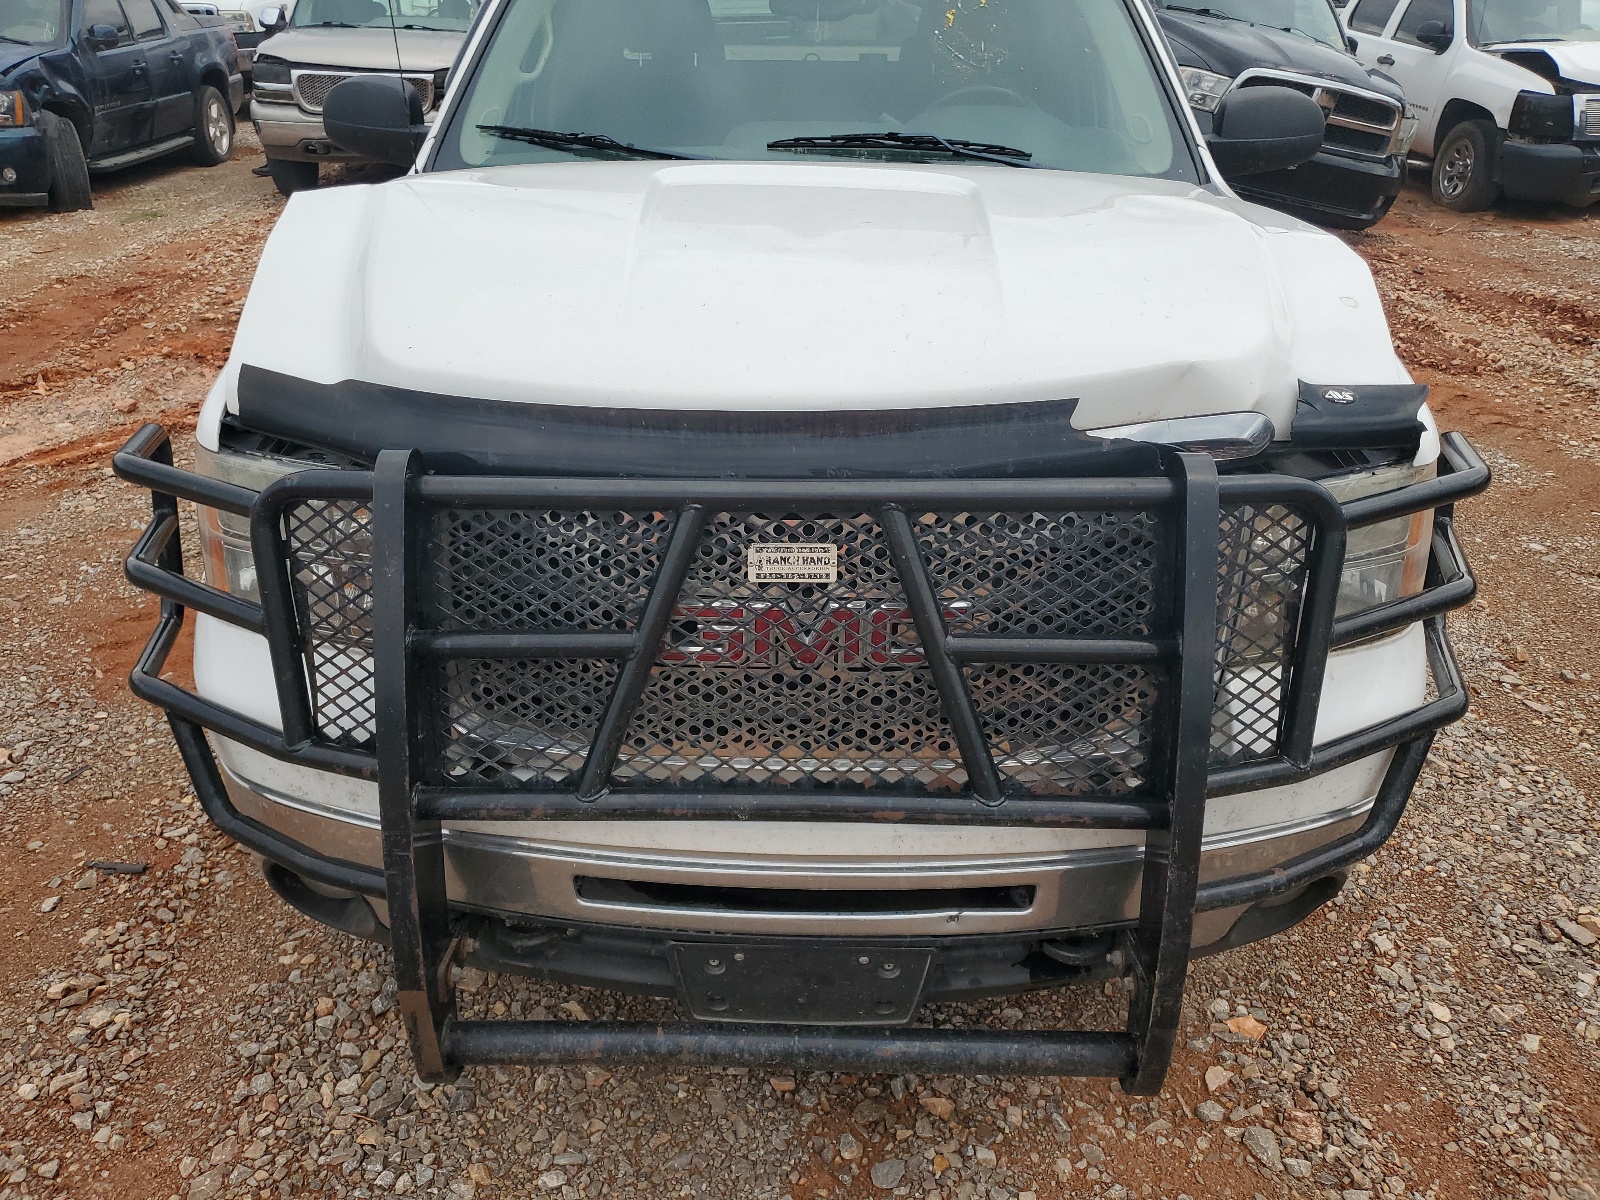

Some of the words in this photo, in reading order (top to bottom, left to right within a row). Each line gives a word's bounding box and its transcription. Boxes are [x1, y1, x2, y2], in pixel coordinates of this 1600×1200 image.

[1324, 390, 1354, 400] AVS
[765, 556, 800, 566] RANCH
[802, 556, 831, 566] HAND
[656, 600, 974, 664] GMC
